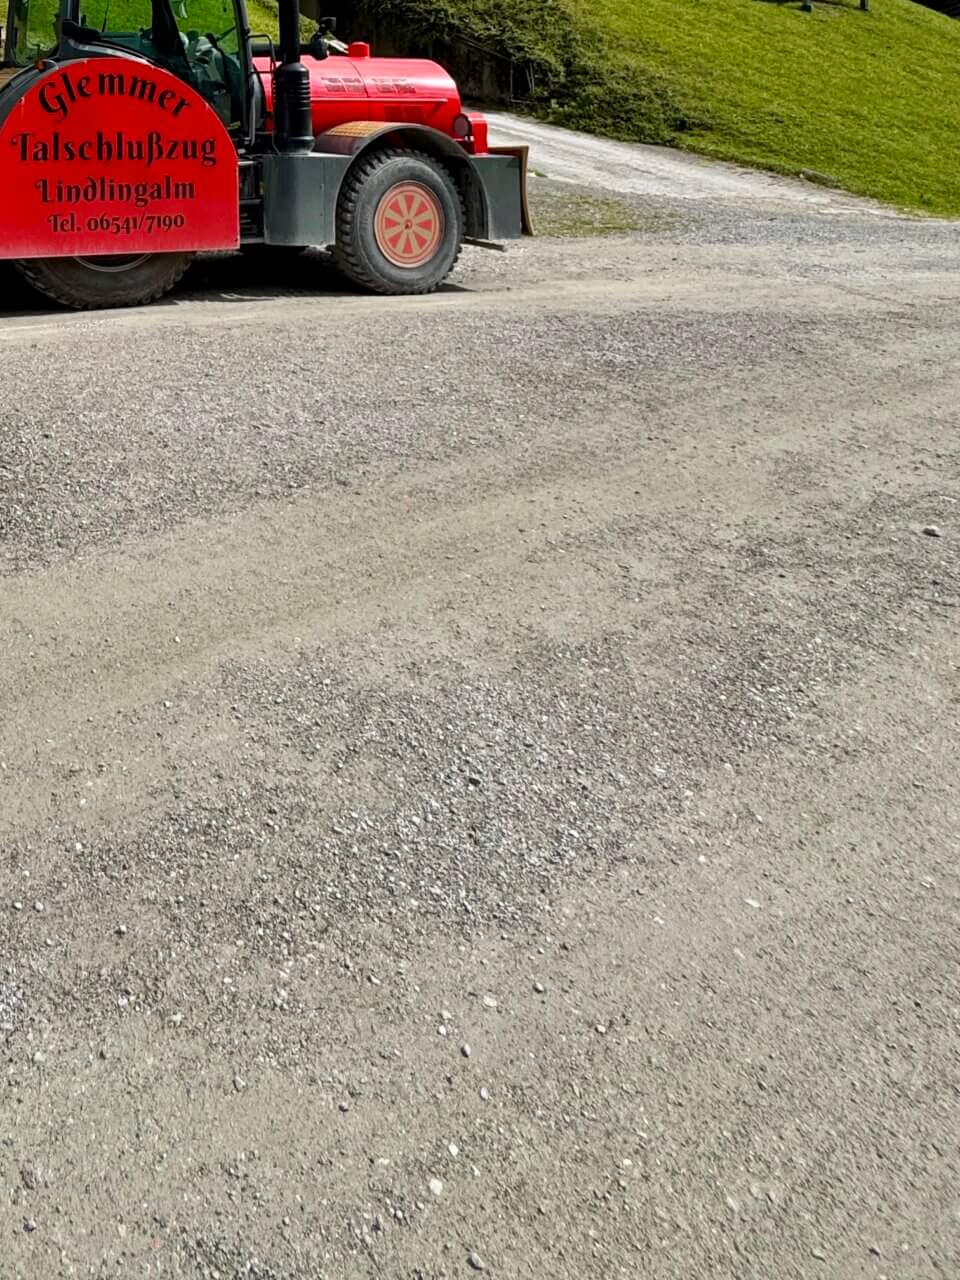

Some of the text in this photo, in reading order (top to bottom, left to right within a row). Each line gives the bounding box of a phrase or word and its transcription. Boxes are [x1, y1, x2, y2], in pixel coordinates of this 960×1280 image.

[38, 71, 191, 121] Glemmer
[11, 131, 217, 167] Talschlußzug
[34, 175, 195, 207] Lindlingalm
[48, 212, 185, 235] Tel. 06541/7190
